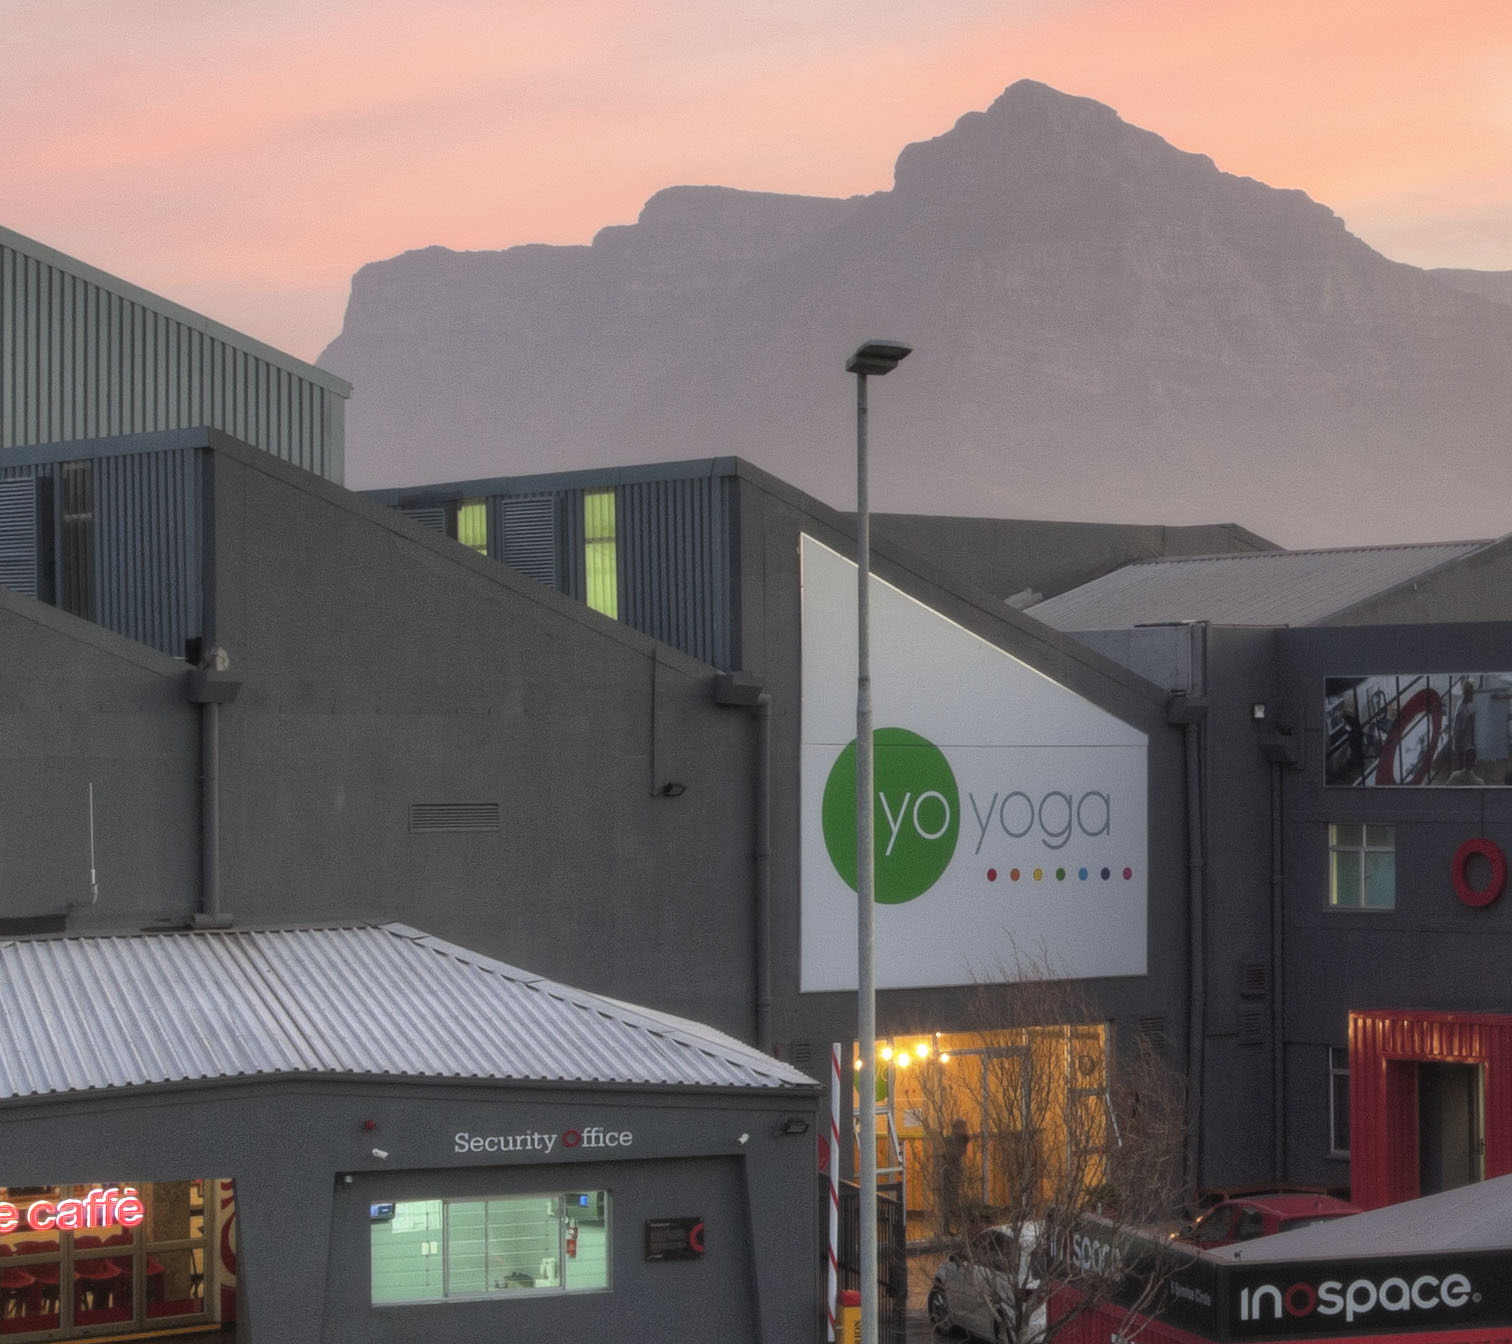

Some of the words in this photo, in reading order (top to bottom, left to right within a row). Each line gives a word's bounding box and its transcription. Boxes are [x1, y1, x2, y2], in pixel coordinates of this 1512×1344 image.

[878, 790, 952, 857] yo
[968, 790, 1111, 856] yoga
[454, 1130, 558, 1154] Security
[562, 1127, 633, 1149] Office
[1240, 1273, 1472, 1323] inospace
